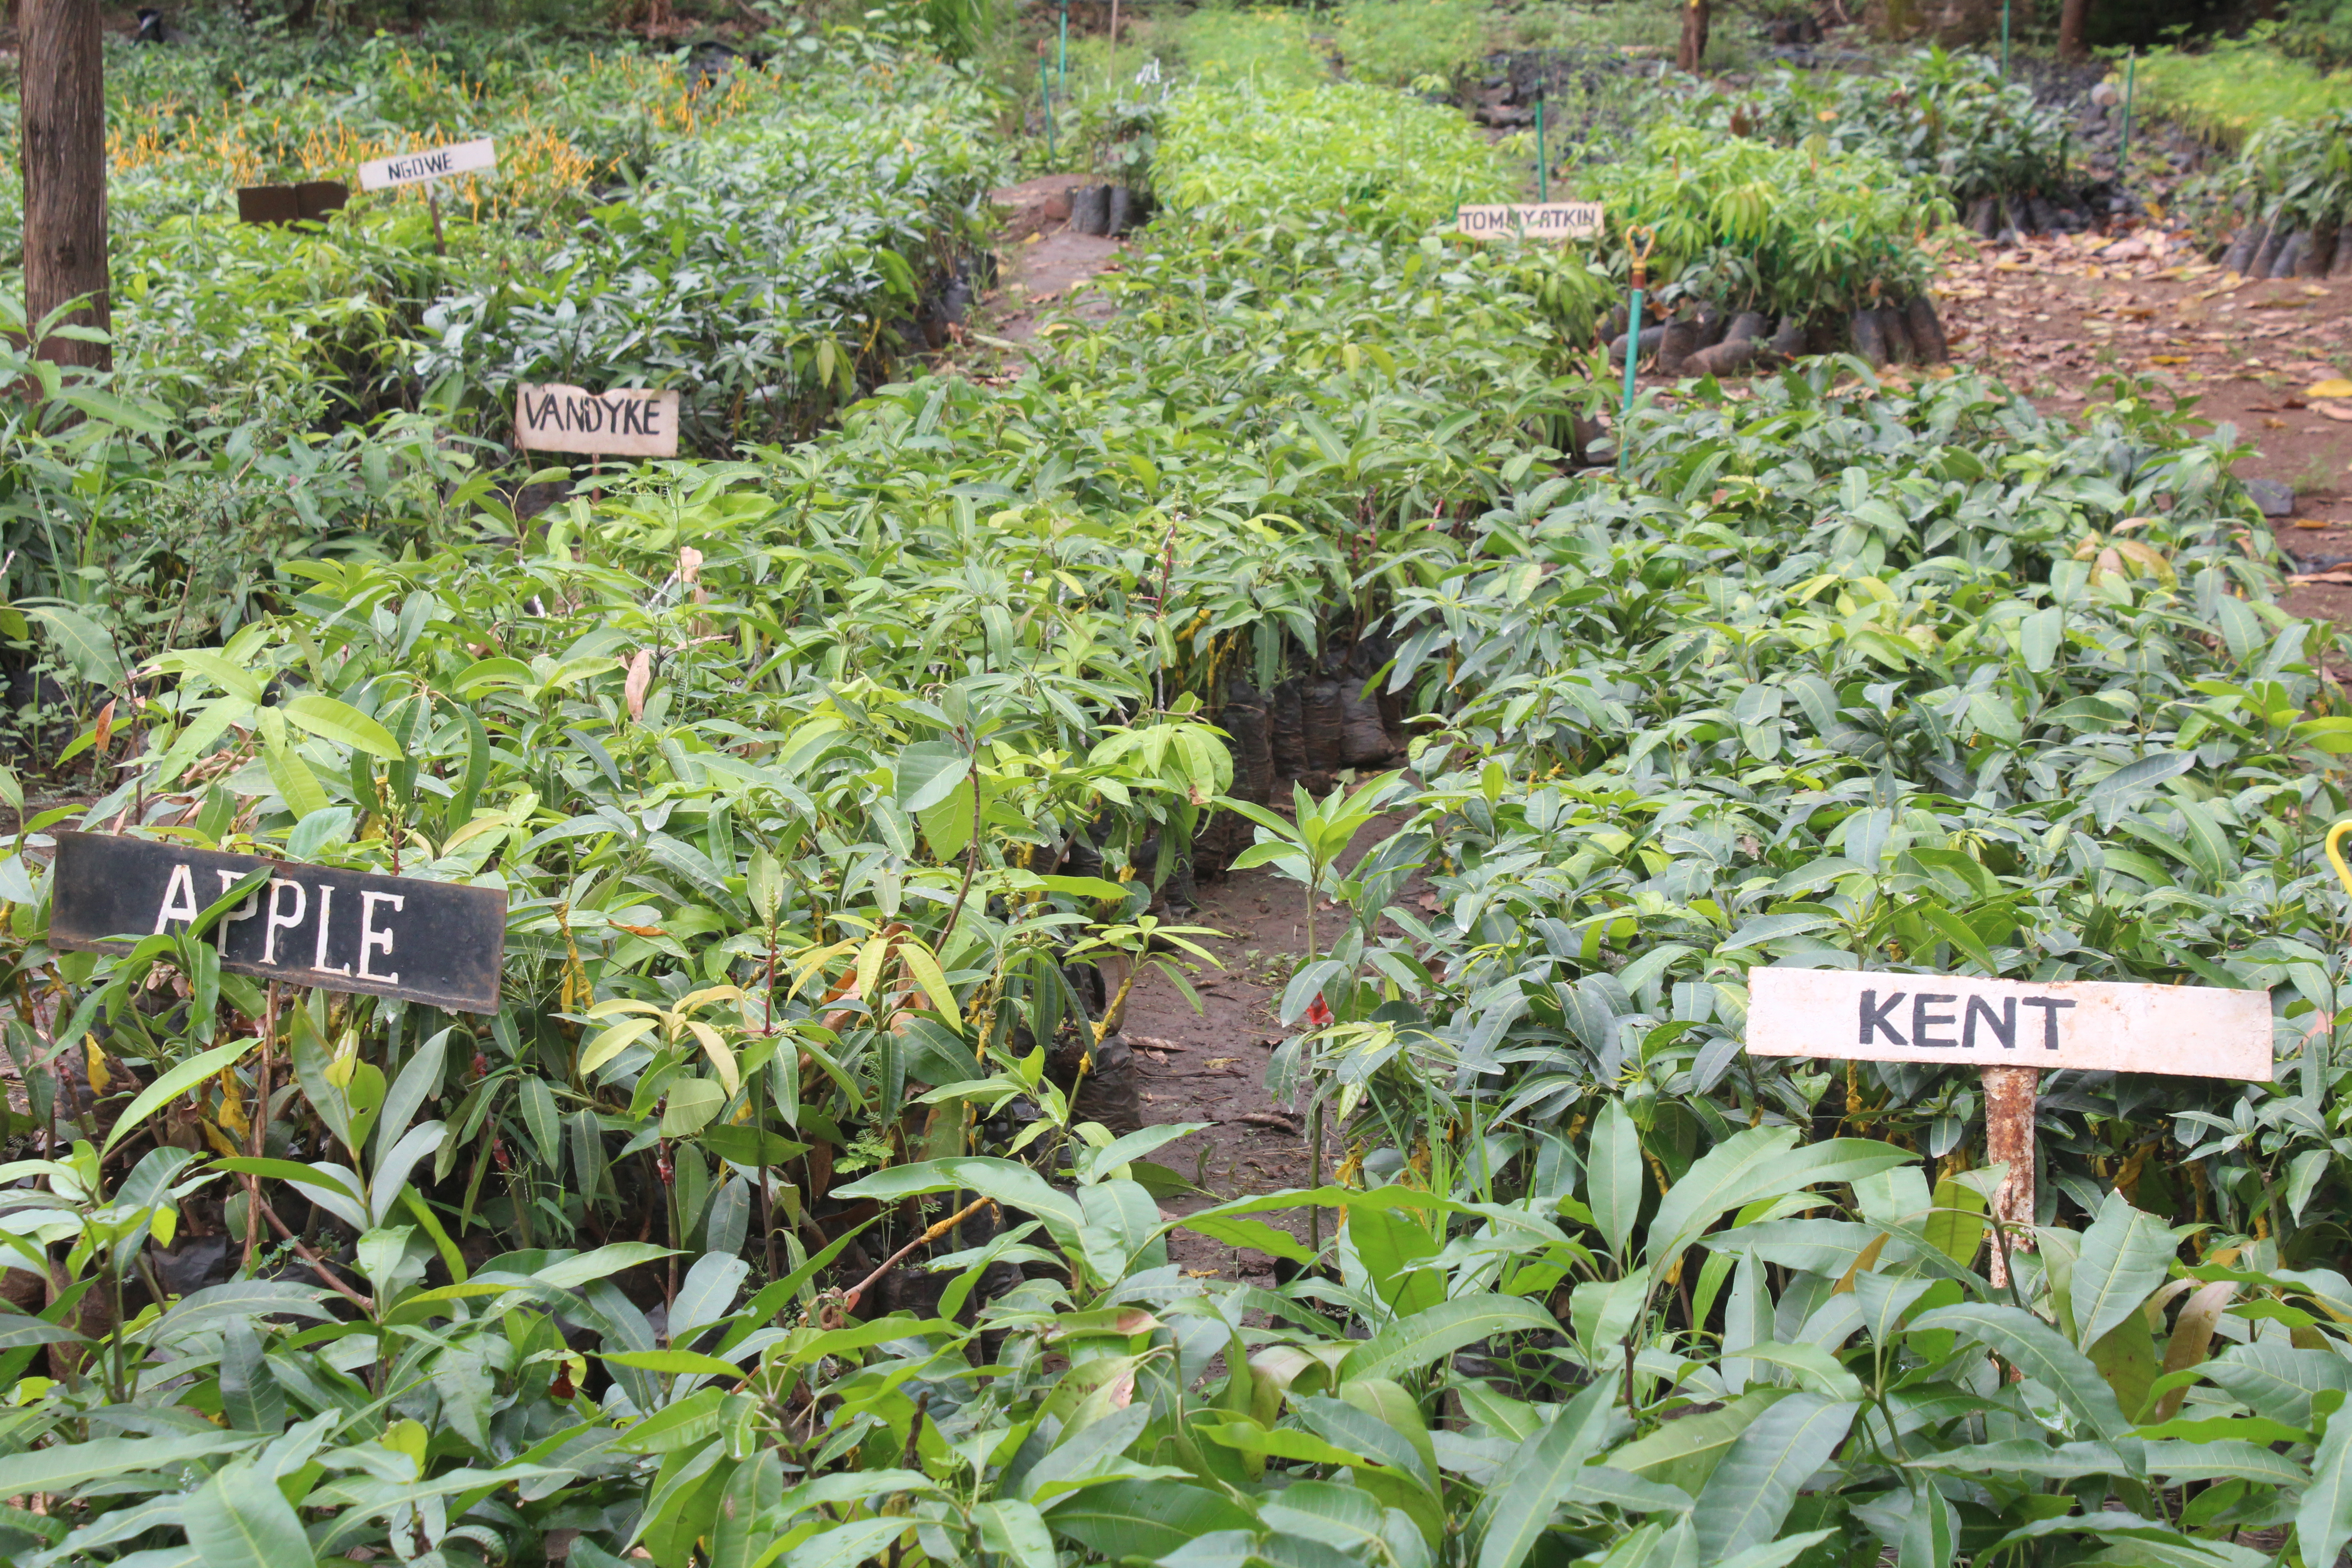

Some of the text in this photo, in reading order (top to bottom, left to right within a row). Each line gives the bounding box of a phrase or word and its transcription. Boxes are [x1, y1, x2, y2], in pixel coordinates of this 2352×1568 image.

[388, 152, 453, 180] NGOWE
[1539, 209, 1595, 228] ATKIN
[525, 392, 660, 435] VANDYKE
[154, 864, 405, 985] APPLE
[1859, 989, 2078, 1050] KENT
